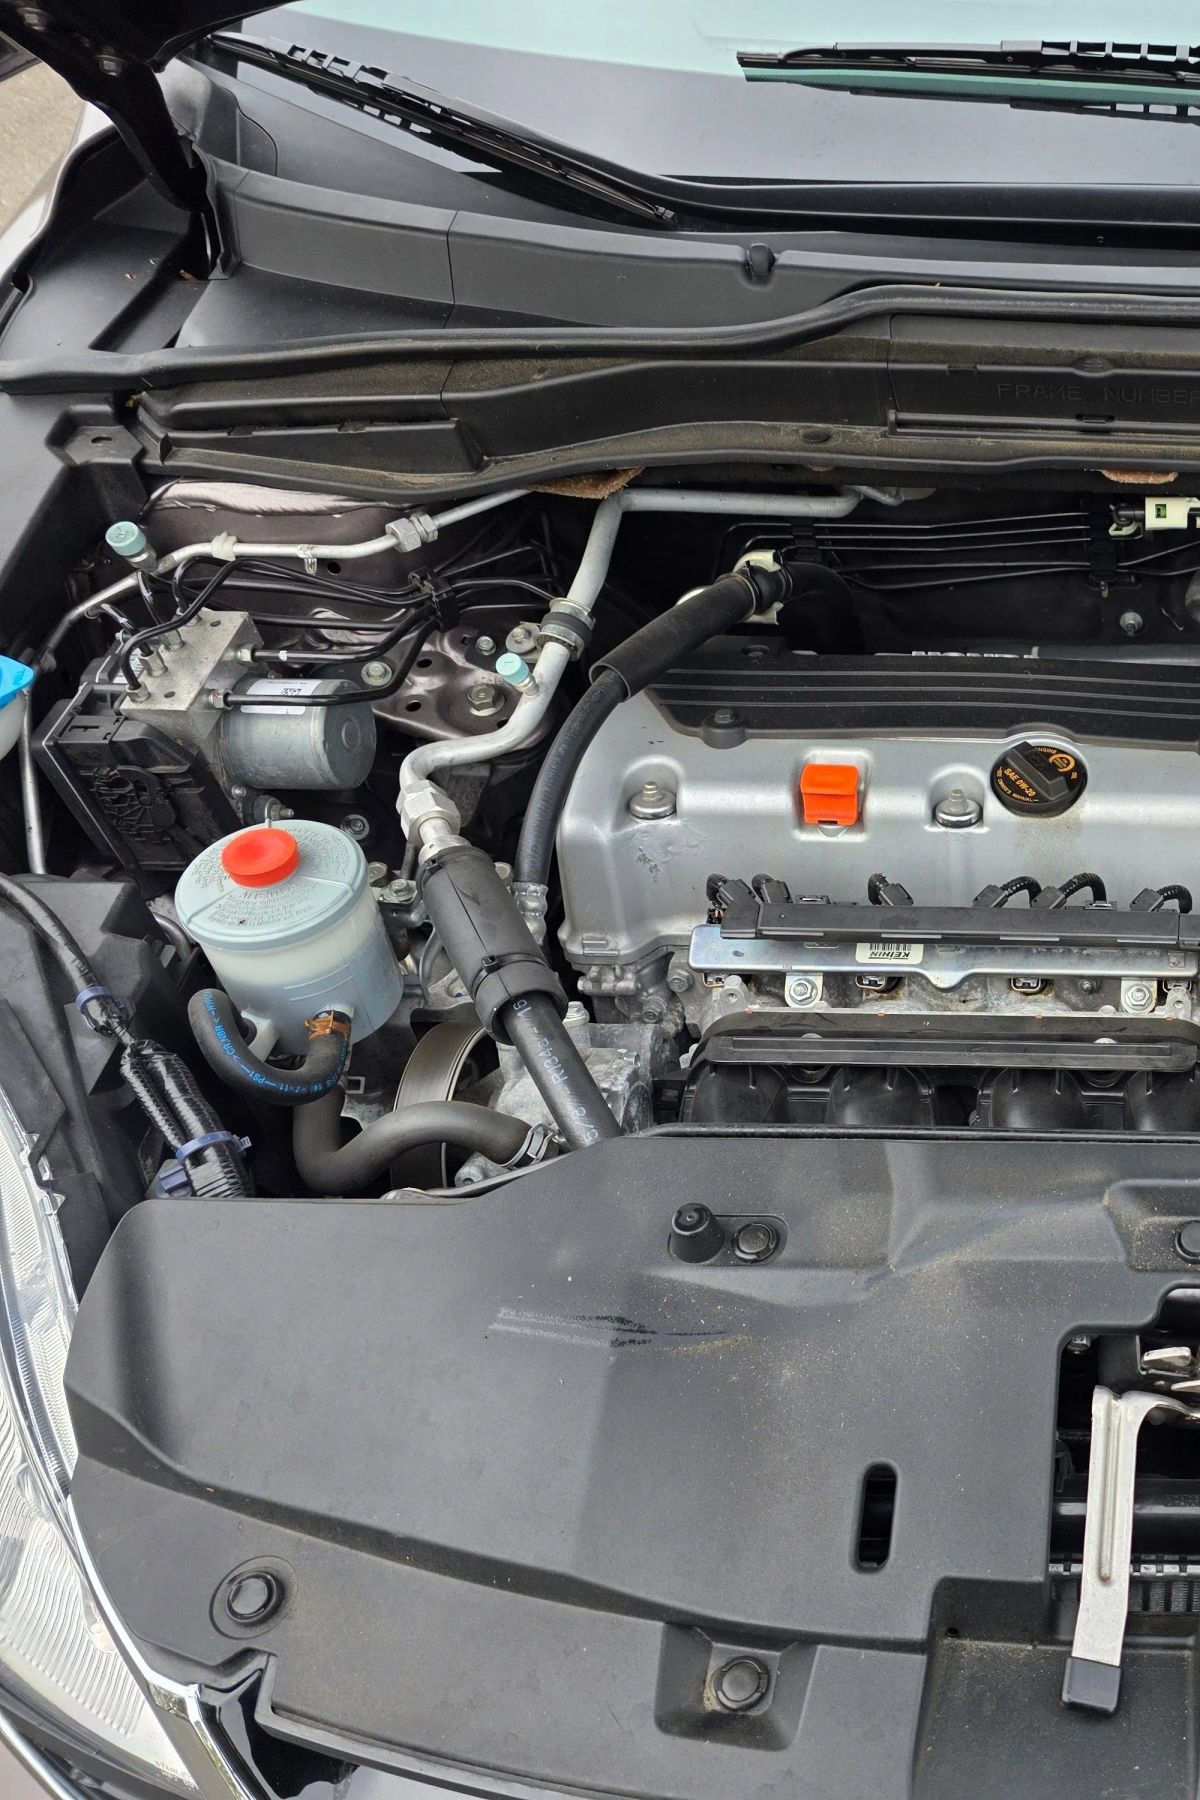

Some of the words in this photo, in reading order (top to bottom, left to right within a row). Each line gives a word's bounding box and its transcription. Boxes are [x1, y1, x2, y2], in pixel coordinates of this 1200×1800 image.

[997, 383, 1082, 401] FRAME
[1004, 768, 1019, 781] SAE
[1016, 779, 1036, 797] 0W-20
[538, 1038, 568, 1085] R134a
